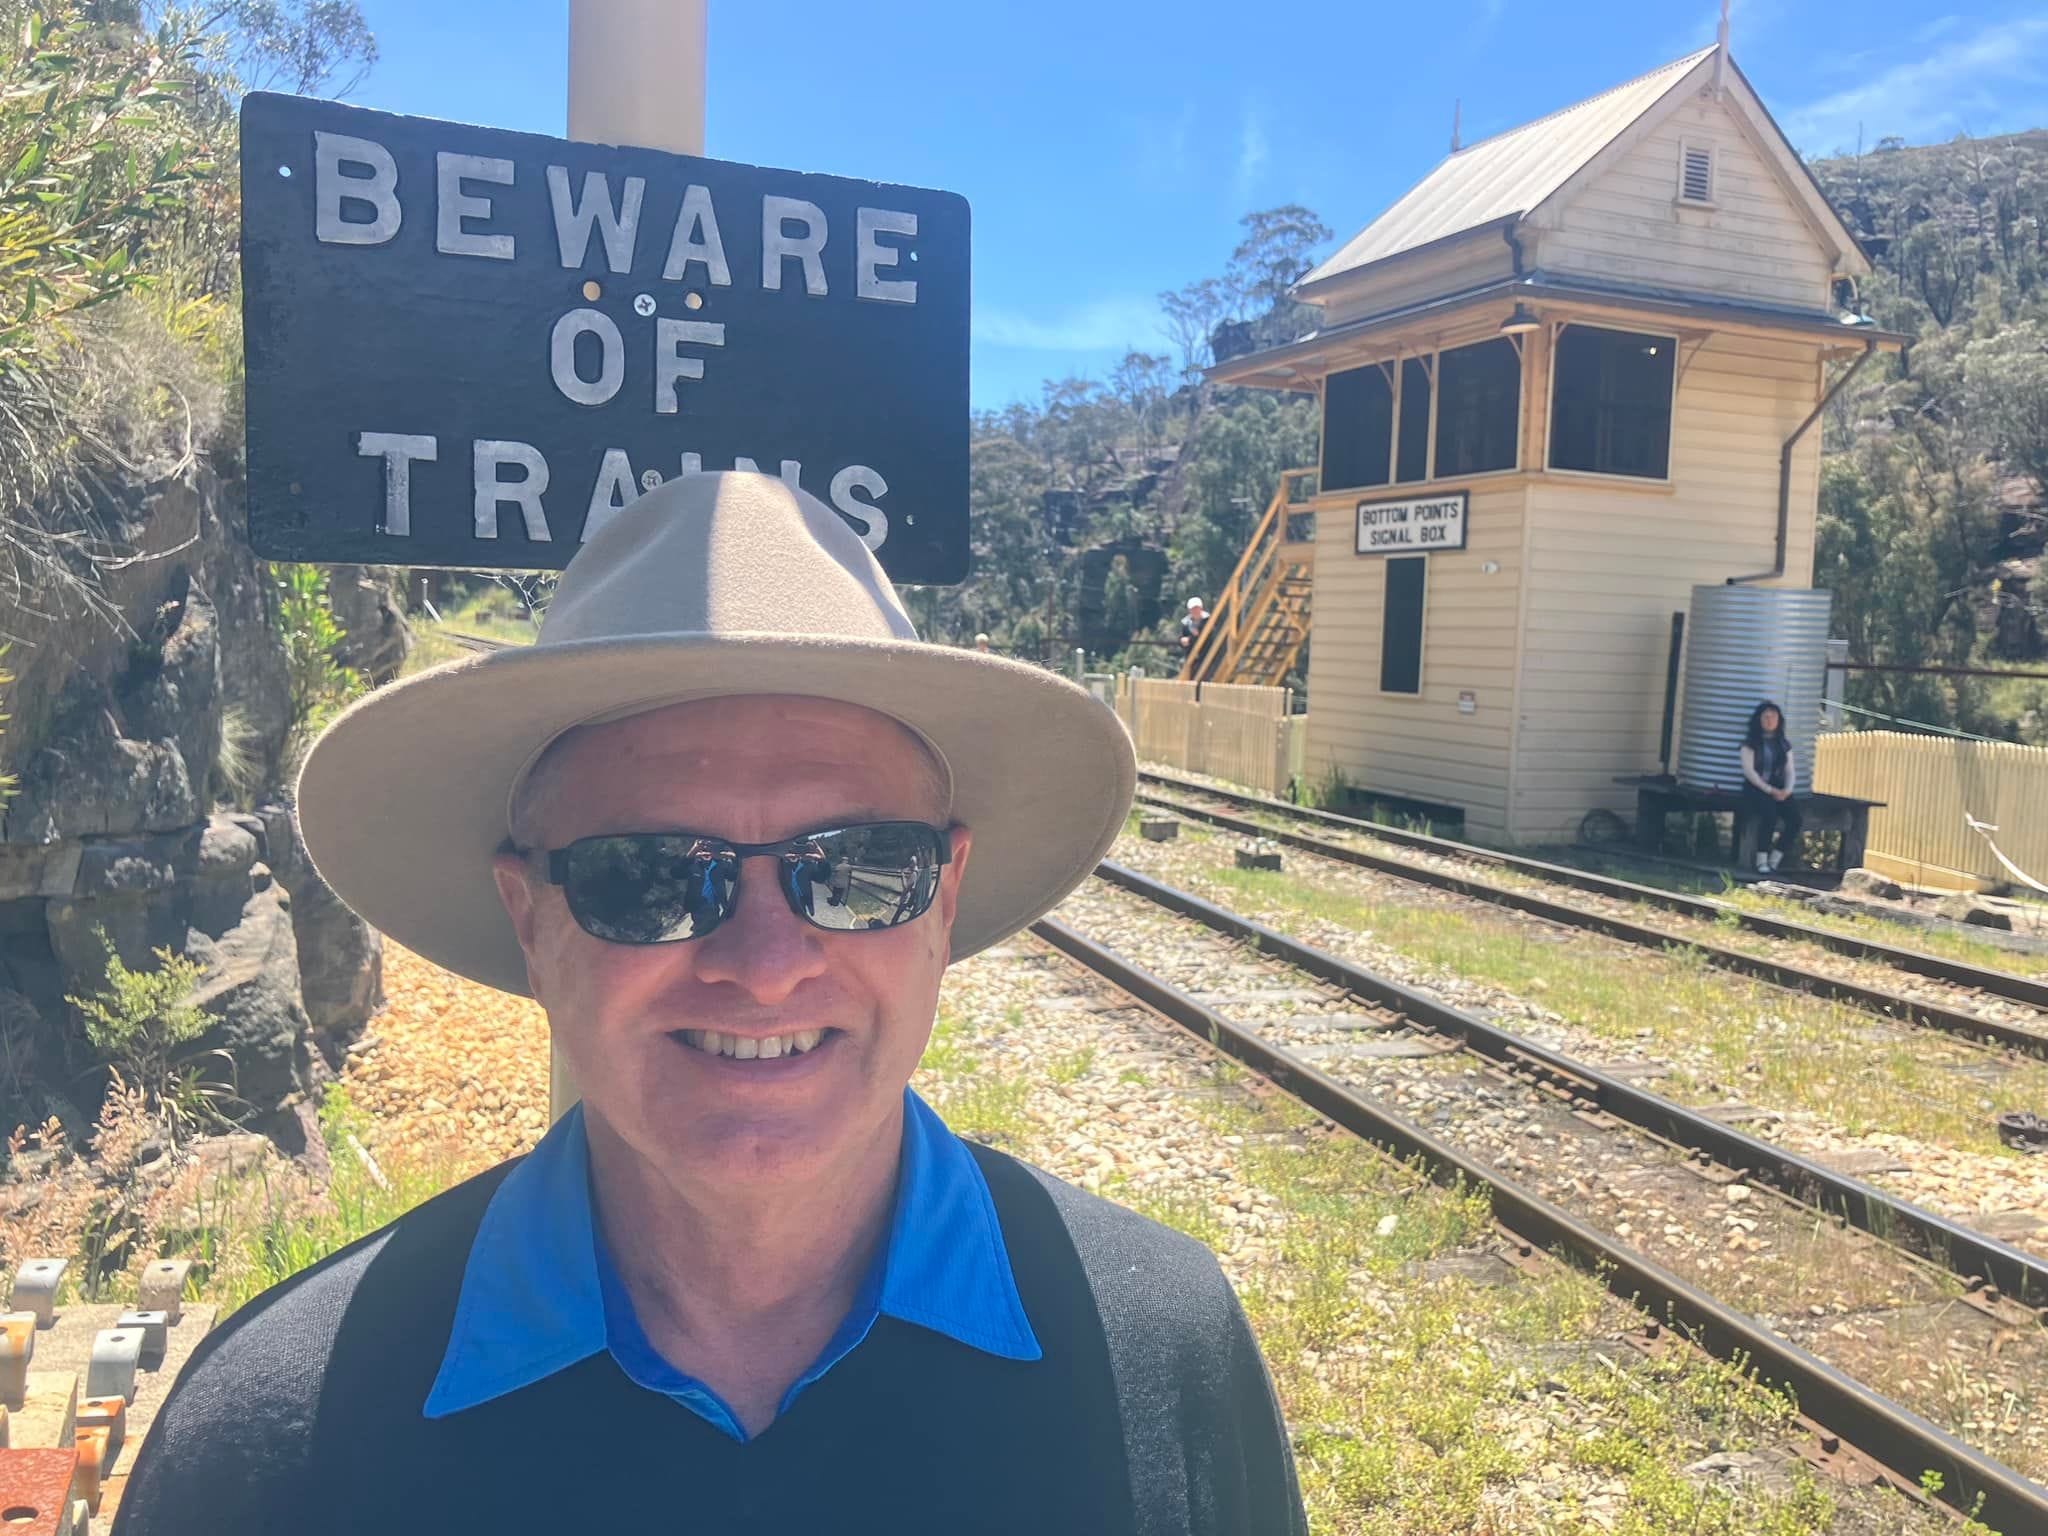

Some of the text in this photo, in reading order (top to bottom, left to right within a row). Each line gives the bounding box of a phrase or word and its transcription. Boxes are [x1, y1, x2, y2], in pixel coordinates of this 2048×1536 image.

[314, 131, 918, 304] BEWARE
[550, 308, 726, 415] OF
[357, 431, 890, 552] TRAS
[1363, 502, 1459, 525] BOTTOM POINTS
[1370, 525, 1447, 545] SIGNAL BOX
